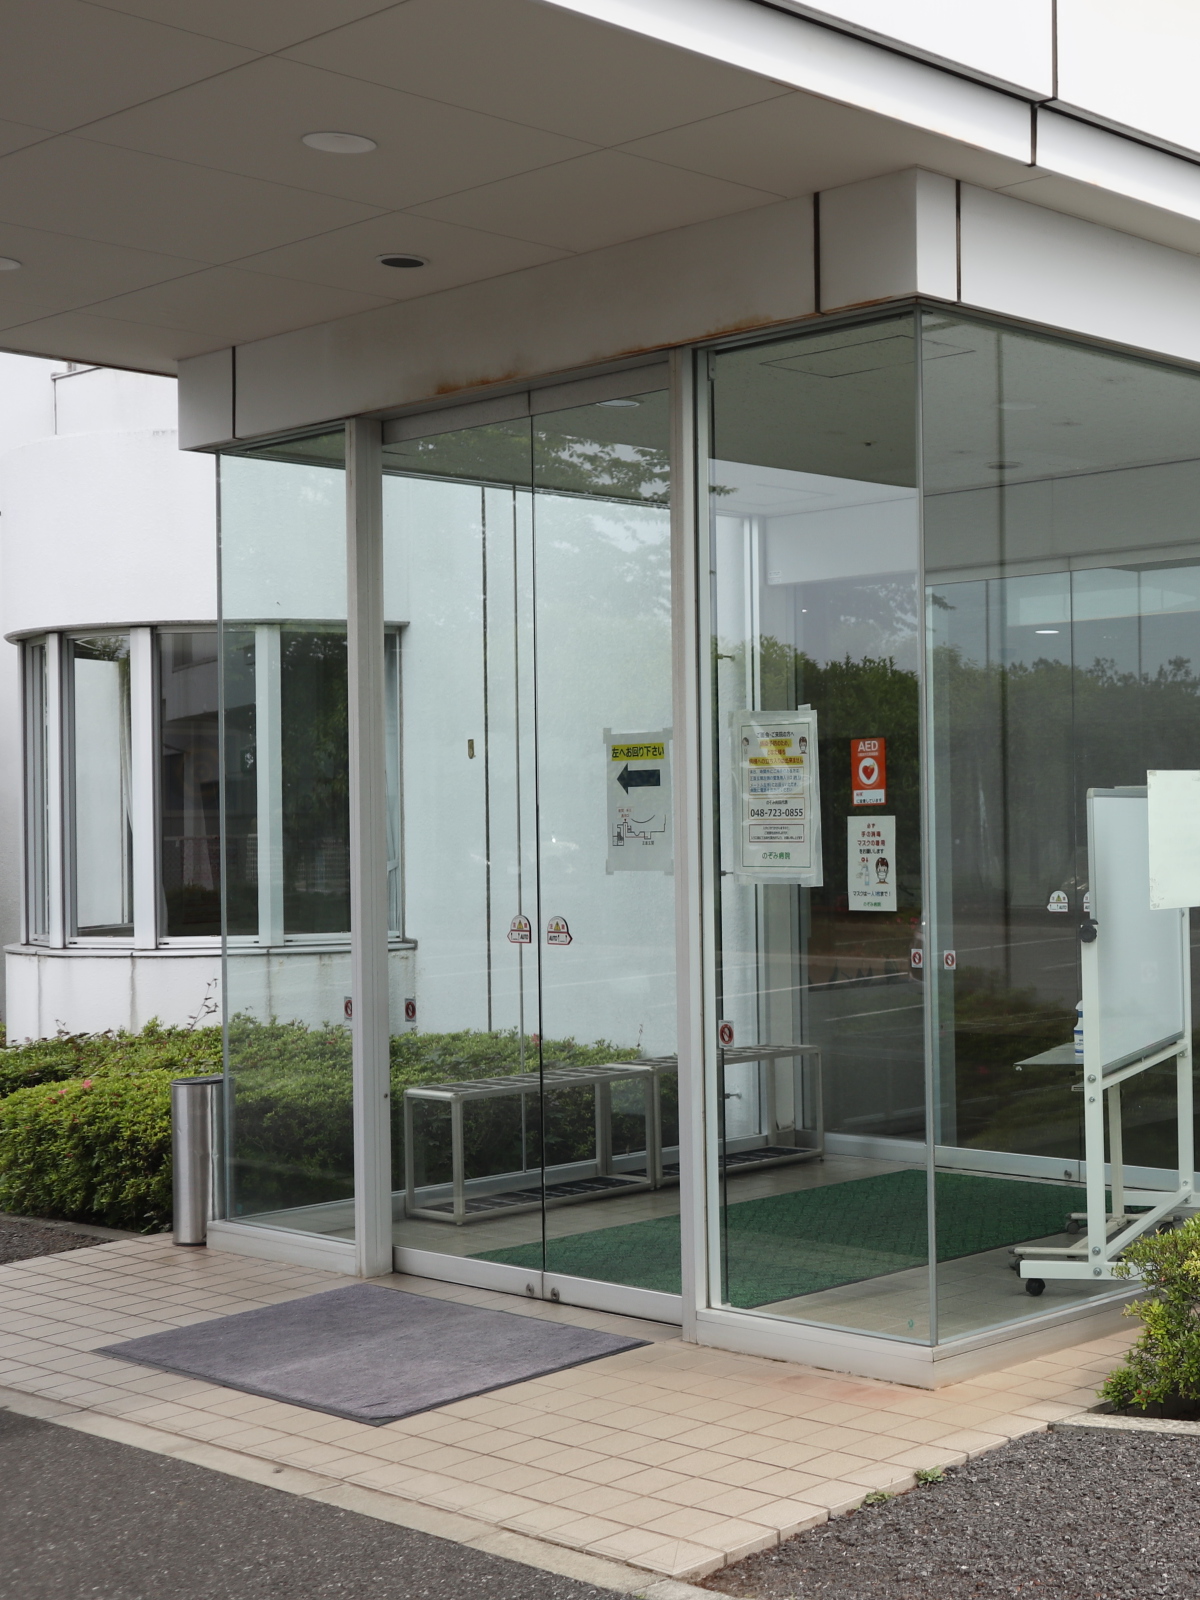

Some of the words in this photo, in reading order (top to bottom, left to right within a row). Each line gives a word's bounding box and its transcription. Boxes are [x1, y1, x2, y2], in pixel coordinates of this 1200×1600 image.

[857, 740, 879, 752] AED
[611, 746, 665, 759] 左へお回り下さい
[750, 808, 804, 818] 048-723-0855
[761, 851, 791, 860] のぞみ病院
